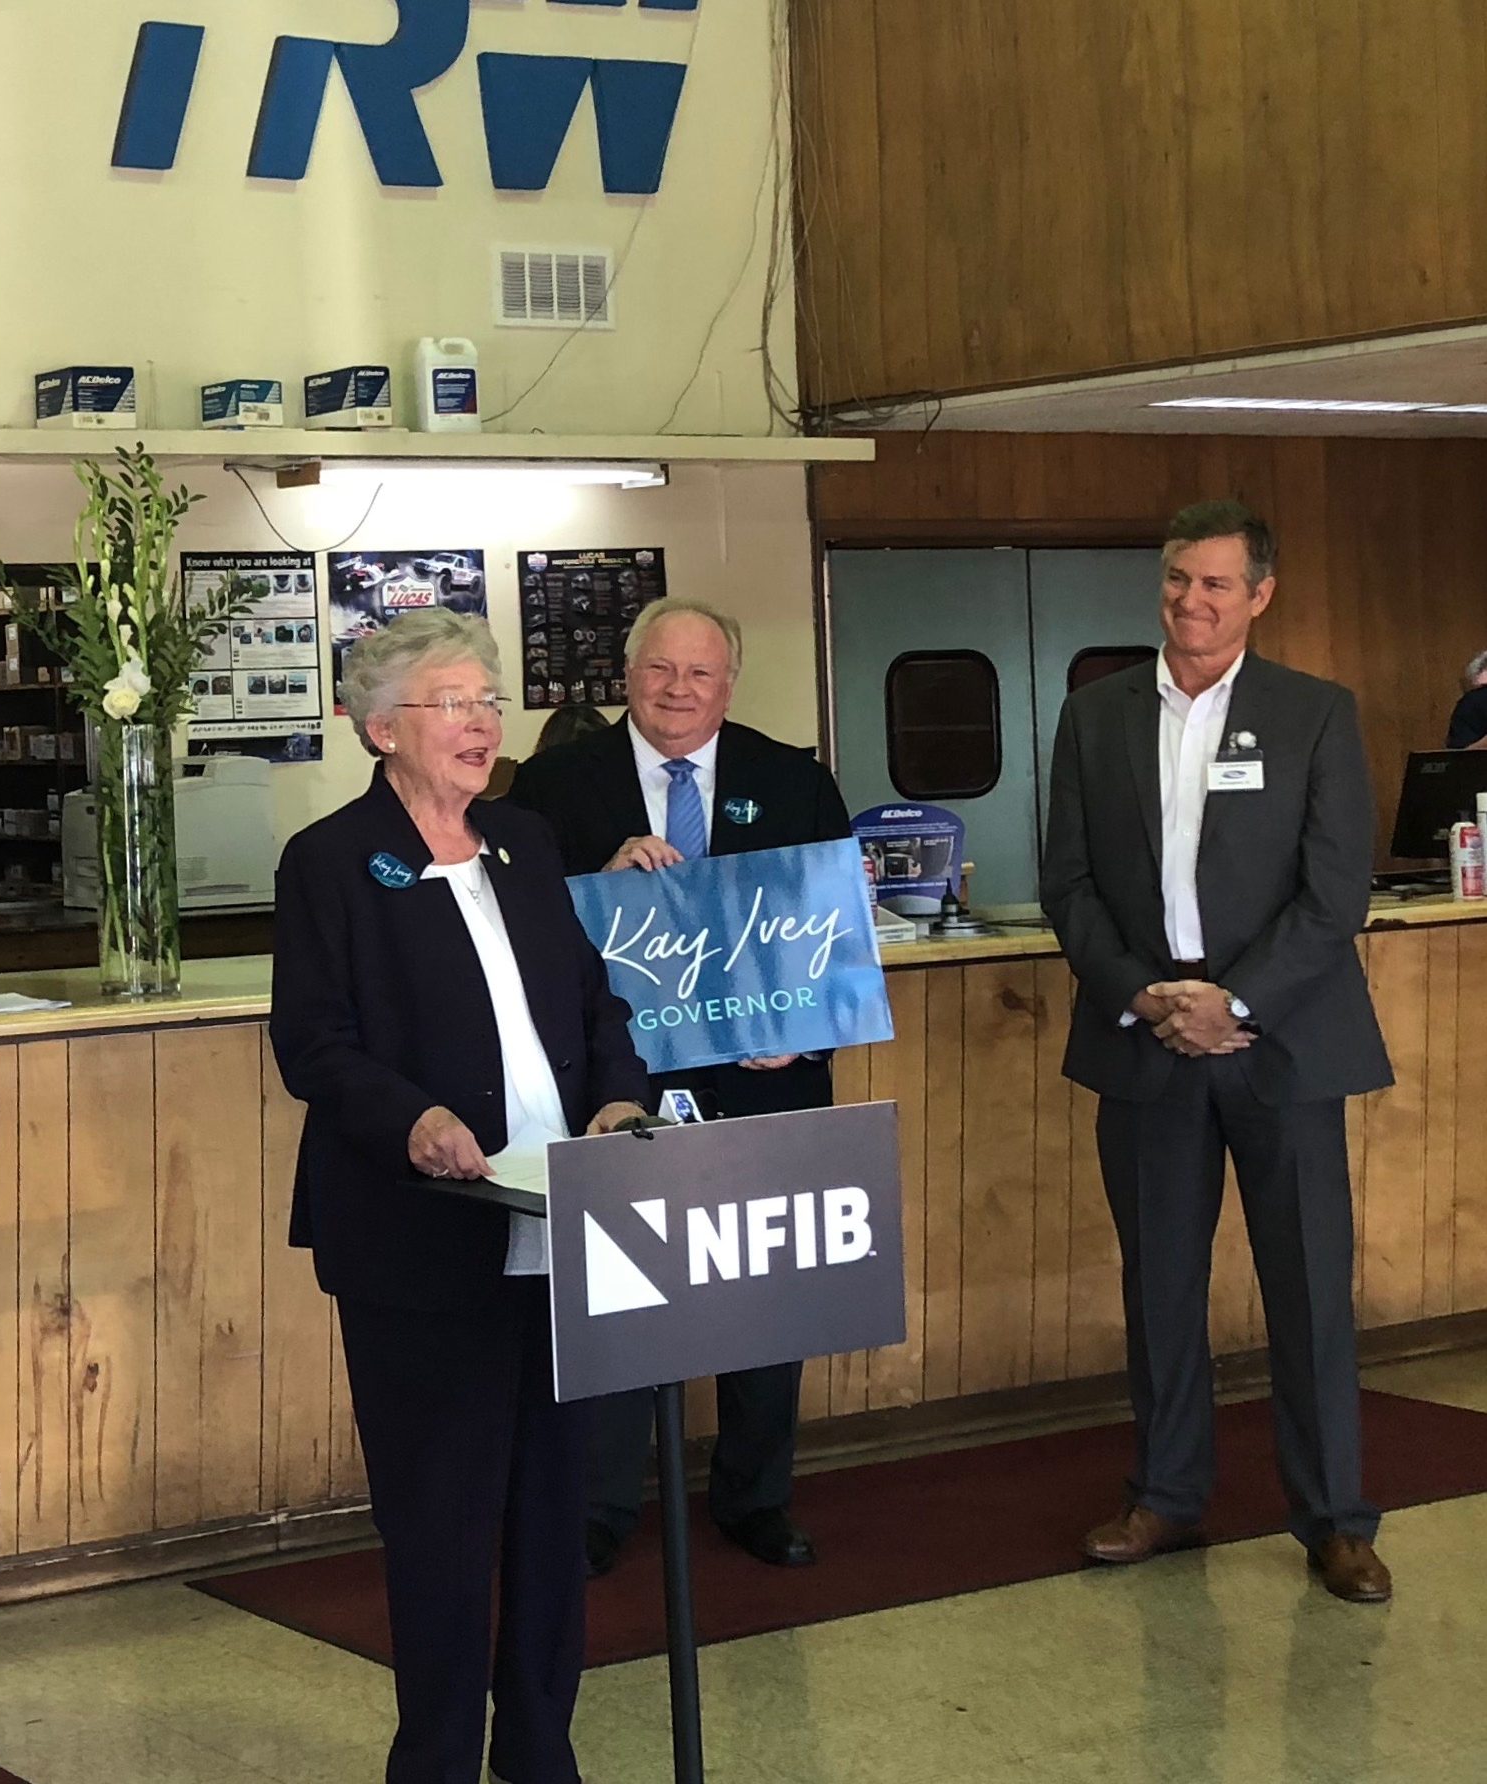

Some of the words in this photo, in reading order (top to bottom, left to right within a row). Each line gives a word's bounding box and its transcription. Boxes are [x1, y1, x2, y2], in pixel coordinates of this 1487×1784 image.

[186, 557, 211, 567] Know
[213, 557, 234, 567] what
[236, 558, 251, 569] you
[254, 558, 268, 567] are
[269, 556, 301, 569] looking
[302, 557, 312, 567] at
[388, 592, 432, 605] LUCAS
[881, 809, 923, 819] ACDelco
[601, 906, 722, 999] Kay
[723, 886, 853, 980] Ivey
[637, 987, 817, 1031] GOVERNOR
[686, 1186, 873, 1286] NFIB
